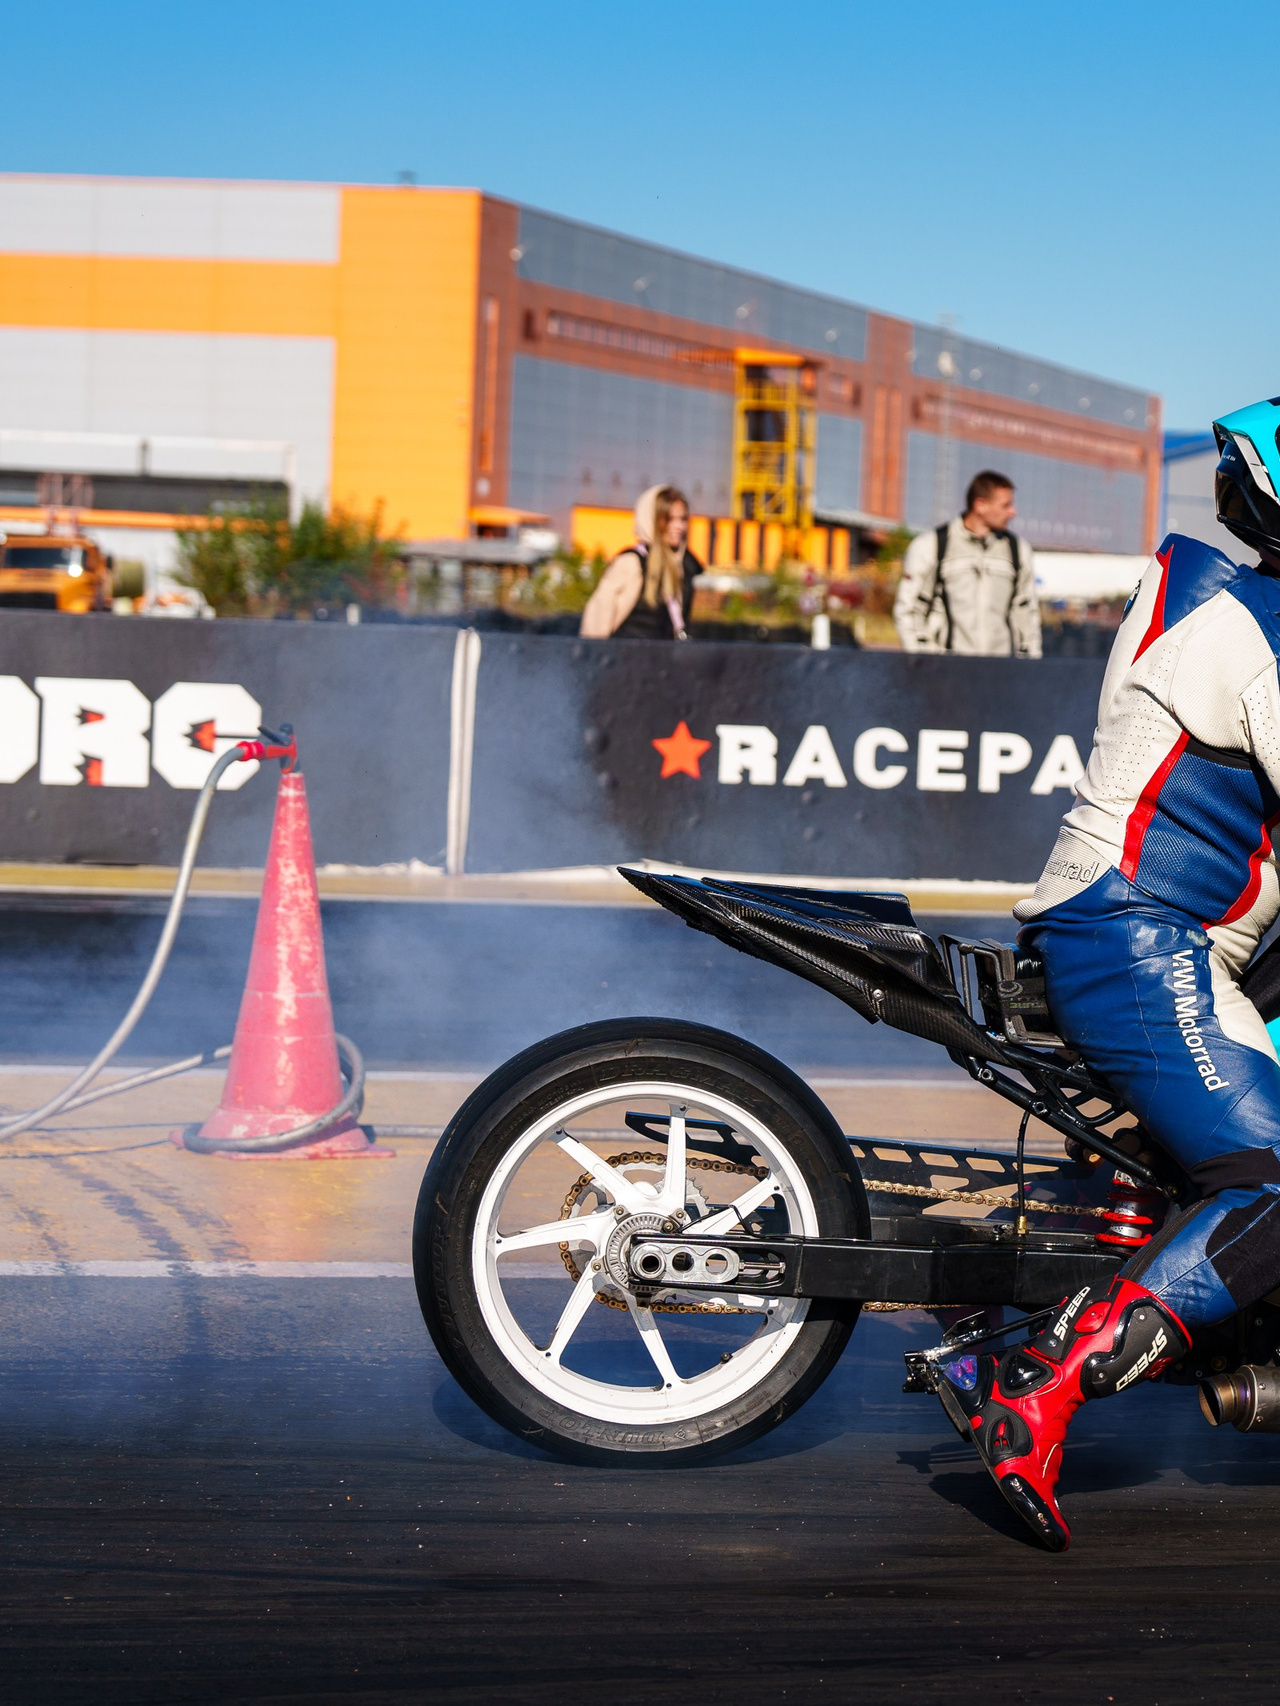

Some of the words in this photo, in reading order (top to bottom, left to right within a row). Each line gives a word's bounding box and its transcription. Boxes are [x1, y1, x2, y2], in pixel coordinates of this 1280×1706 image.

[1174, 995, 1230, 1092] Motorrad
[1053, 1286, 1091, 1341] SPEED
[1115, 1327, 1168, 1392] SPEED
[538, 1408, 665, 1445] DUNLOP
